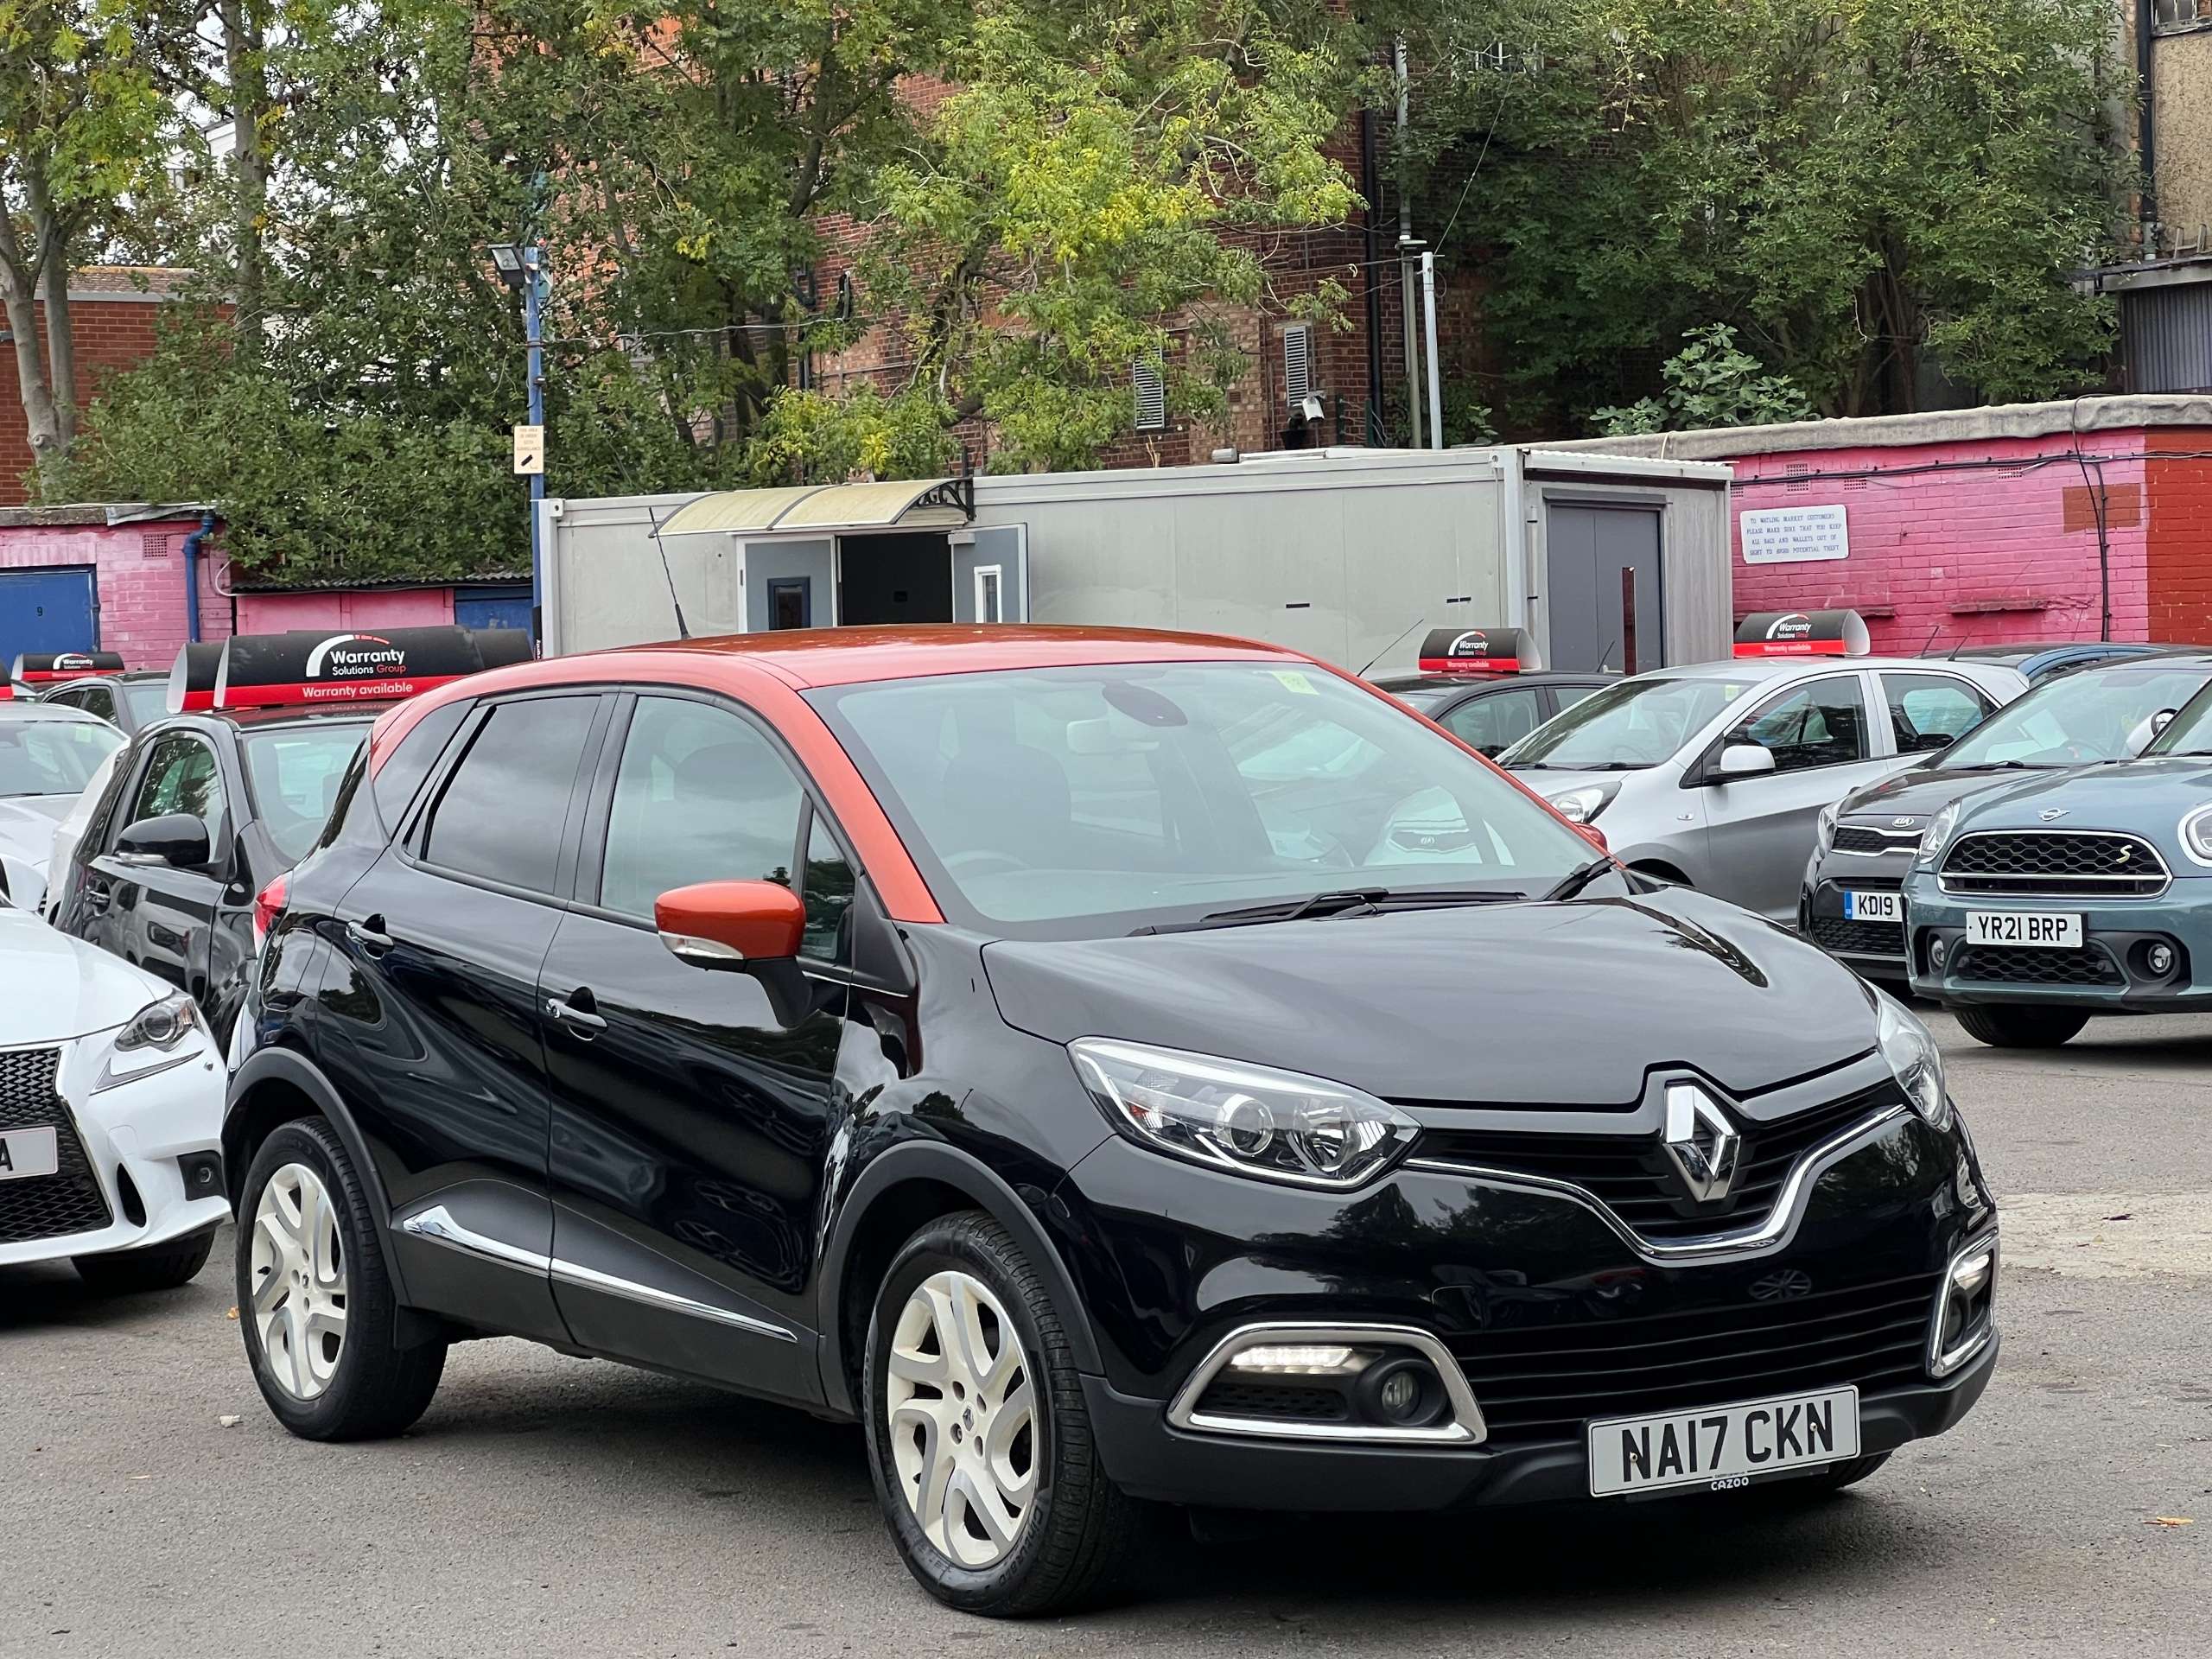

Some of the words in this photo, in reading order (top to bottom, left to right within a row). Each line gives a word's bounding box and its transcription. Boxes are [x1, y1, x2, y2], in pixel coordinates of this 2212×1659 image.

[1780, 623, 1811, 632] Warranty
[1459, 640, 1489, 652] Warranty
[329, 649, 405, 665] Warranty
[332, 665, 374, 676] Solutions
[377, 664, 407, 675] Group
[302, 685, 356, 699] Warranty
[359, 682, 413, 695] available
[1894, 817, 1913, 827] KIA
[1859, 894, 1893, 916] KD19
[1978, 916, 2022, 940] YR21
[2028, 917, 2068, 941] BRP
[1622, 1415, 1728, 1483] NA17
[1745, 1399, 1834, 1464] CKN
[1711, 1477, 1750, 1491] CAZOO
